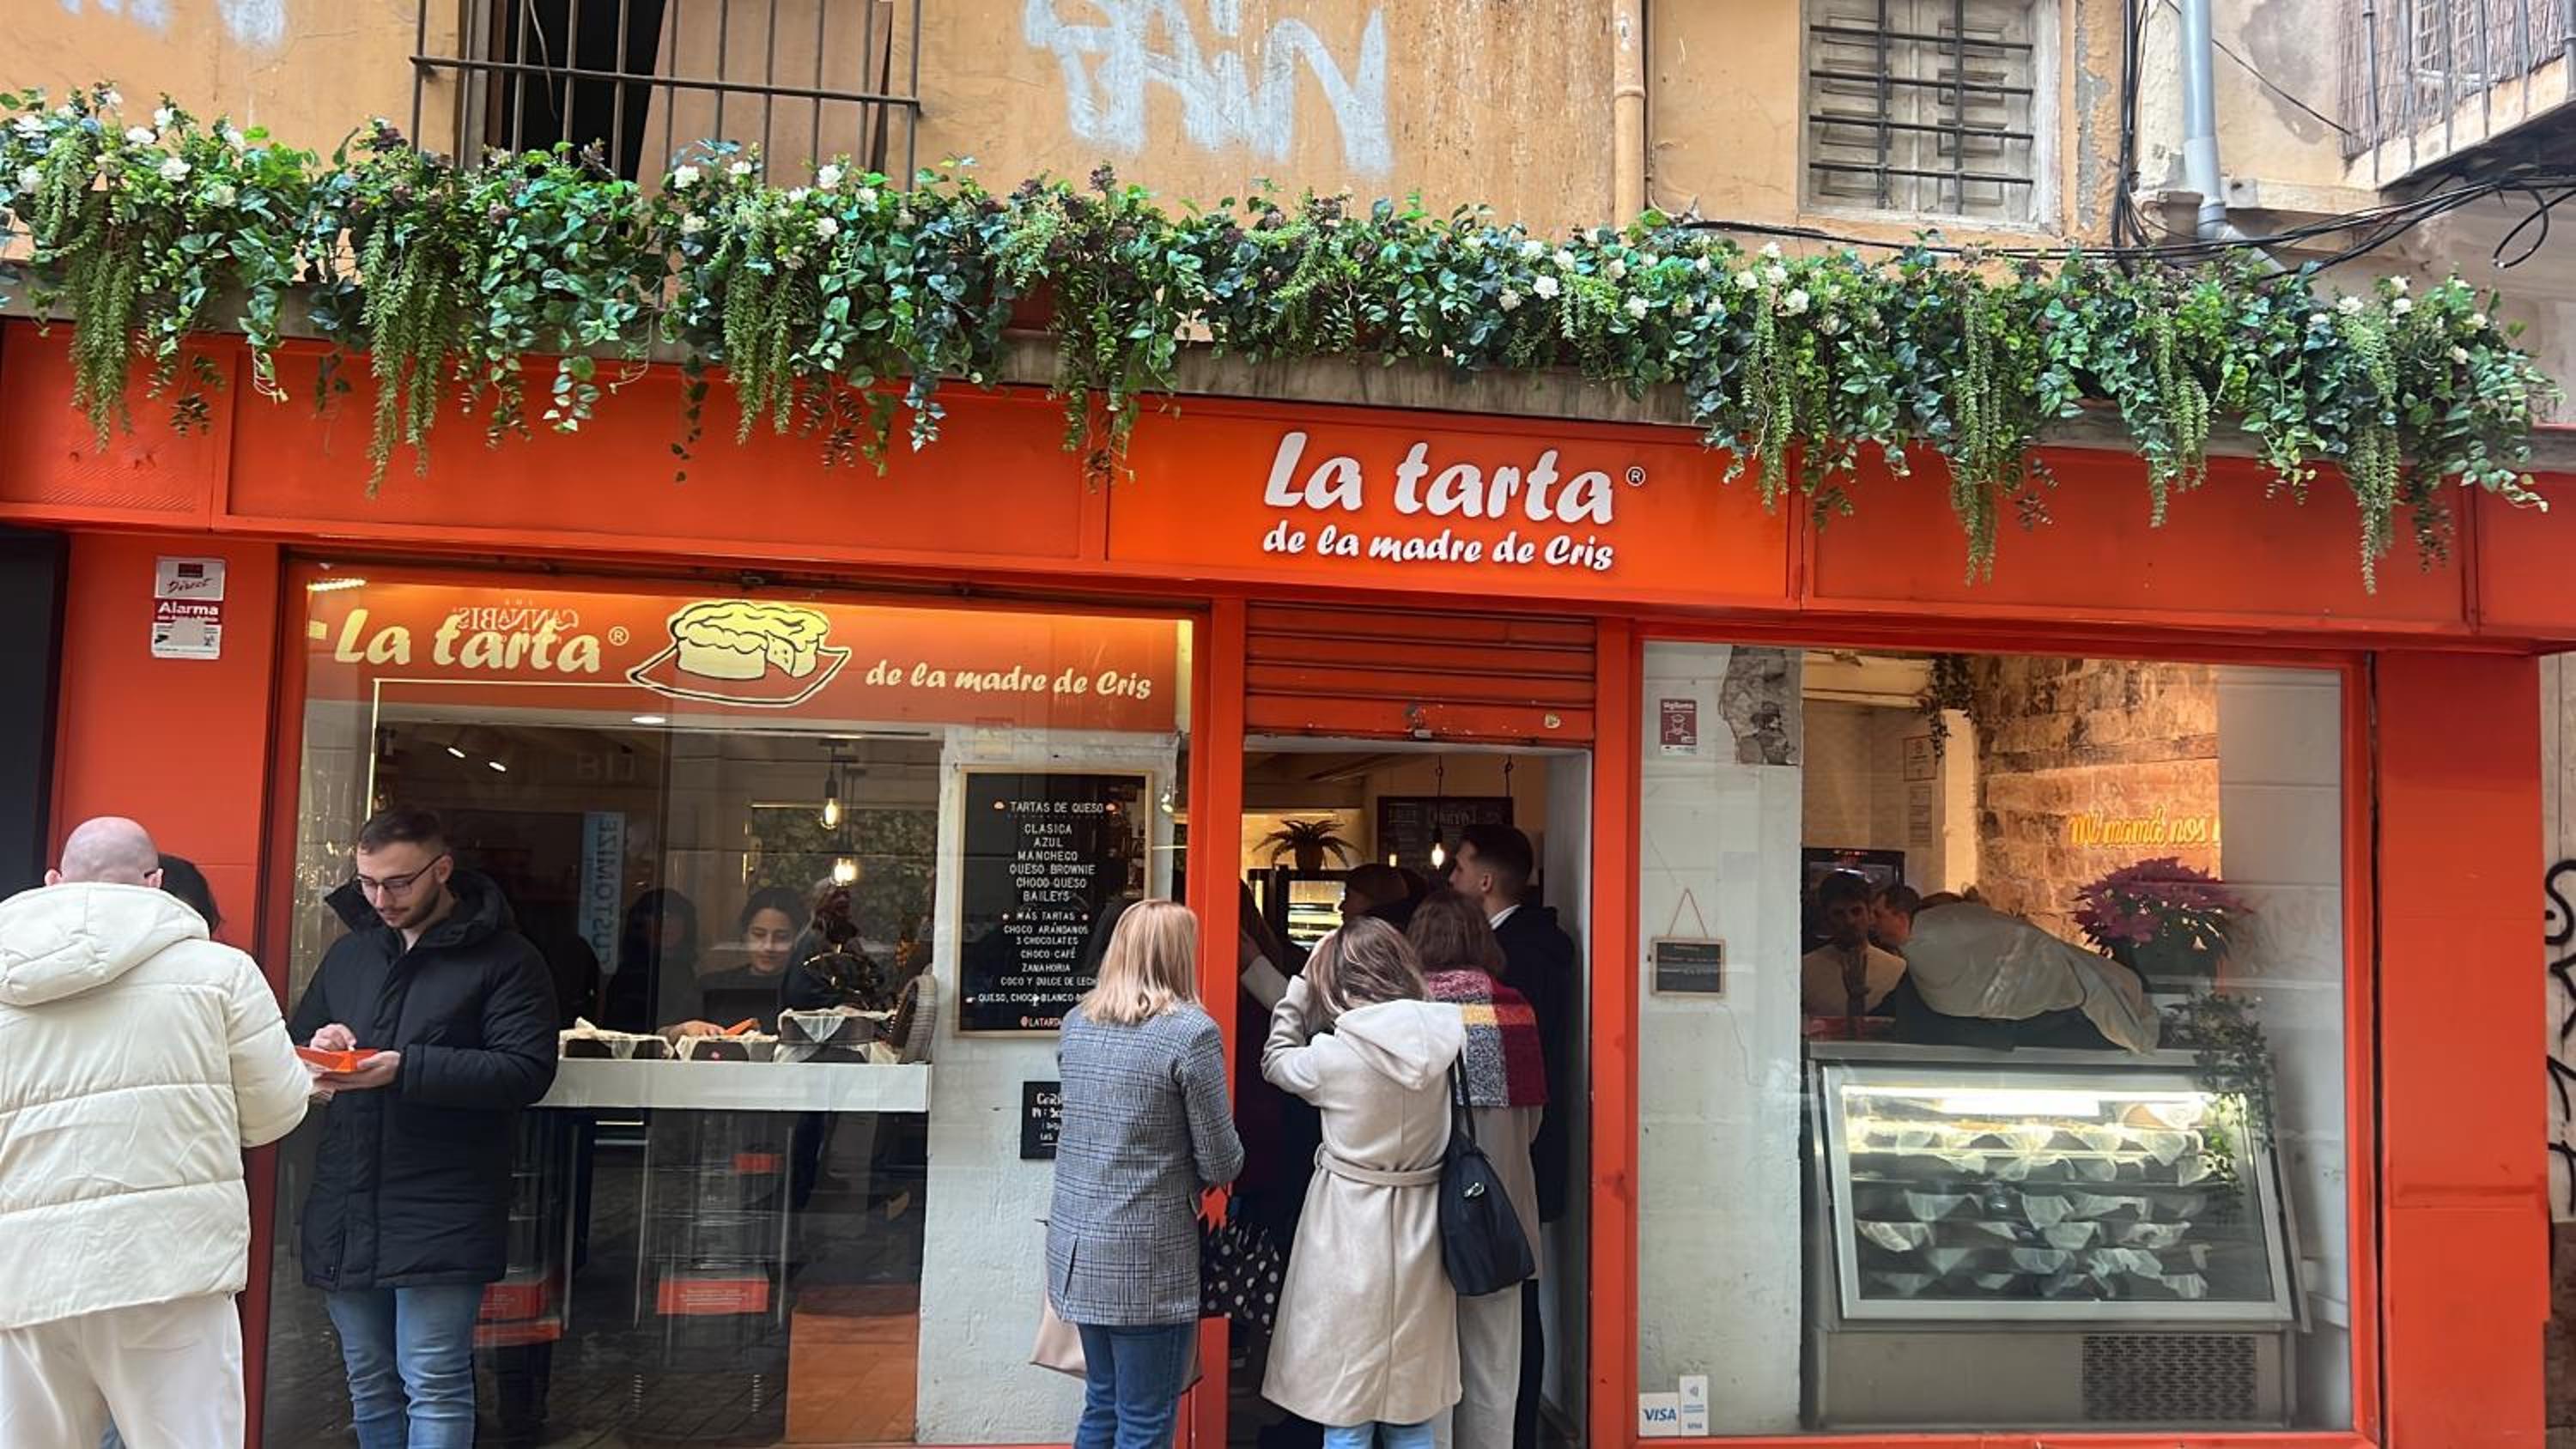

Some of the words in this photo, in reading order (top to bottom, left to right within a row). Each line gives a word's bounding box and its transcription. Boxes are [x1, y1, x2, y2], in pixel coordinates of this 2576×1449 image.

[1263, 431, 1364, 512] La
[1394, 442, 1614, 524] tarta
[1262, 520, 1306, 554] de
[1316, 524, 1359, 556] la
[1368, 529, 1482, 563] madre
[1492, 530, 1534, 564] de
[1545, 534, 1614, 571] Cris
[157, 601, 220, 616] Alarma
[334, 608, 411, 666] La
[433, 613, 601, 674] tarta
[865, 659, 902, 687] de
[910, 662, 945, 688] la
[954, 665, 1047, 693] madre
[1053, 667, 1088, 695] de
[1096, 670, 1151, 700] Cris
[1010, 801, 1050, 813] TARTAS
[1054, 802, 1068, 813] DE
[1072, 802, 1103, 814] QUESO
[1024, 823, 1072, 835] CLASICA
[2104, 804, 2167, 845] mamá
[2171, 815, 2206, 843] nos
[1034, 837, 1064, 847] AZUL
[1018, 851, 1078, 861] MANCHEGO
[1009, 864, 1045, 876] QUESO
[1050, 864, 1096, 876] BROWNIE
[1054, 876, 1087, 888] QUESO
[1023, 890, 1072, 901] BAILEYS
[1016, 908, 1038, 920] MÁS
[1042, 911, 1075, 920] TARTAS
[1004, 925, 1033, 934] CHOCO
[1038, 922, 1089, 934] ARÁNDANOS
[1016, 937, 1021, 945] 3
[1024, 937, 1078, 945] CHOCOLATES
[1020, 949, 1050, 959] CHOCO
[1054, 947, 1076, 959] CAFÉ
[1021, 962, 1071, 973] ZANAHORIA
[1000, 976, 1024, 986] COCO
[1026, 976, 1033, 986] Y
[1036, 976, 1062, 986] DULCE
[1064, 976, 1074, 986] DE
[1041, 993, 1074, 1003] BLANCO
[1643, 1408, 1677, 1422] VISA
